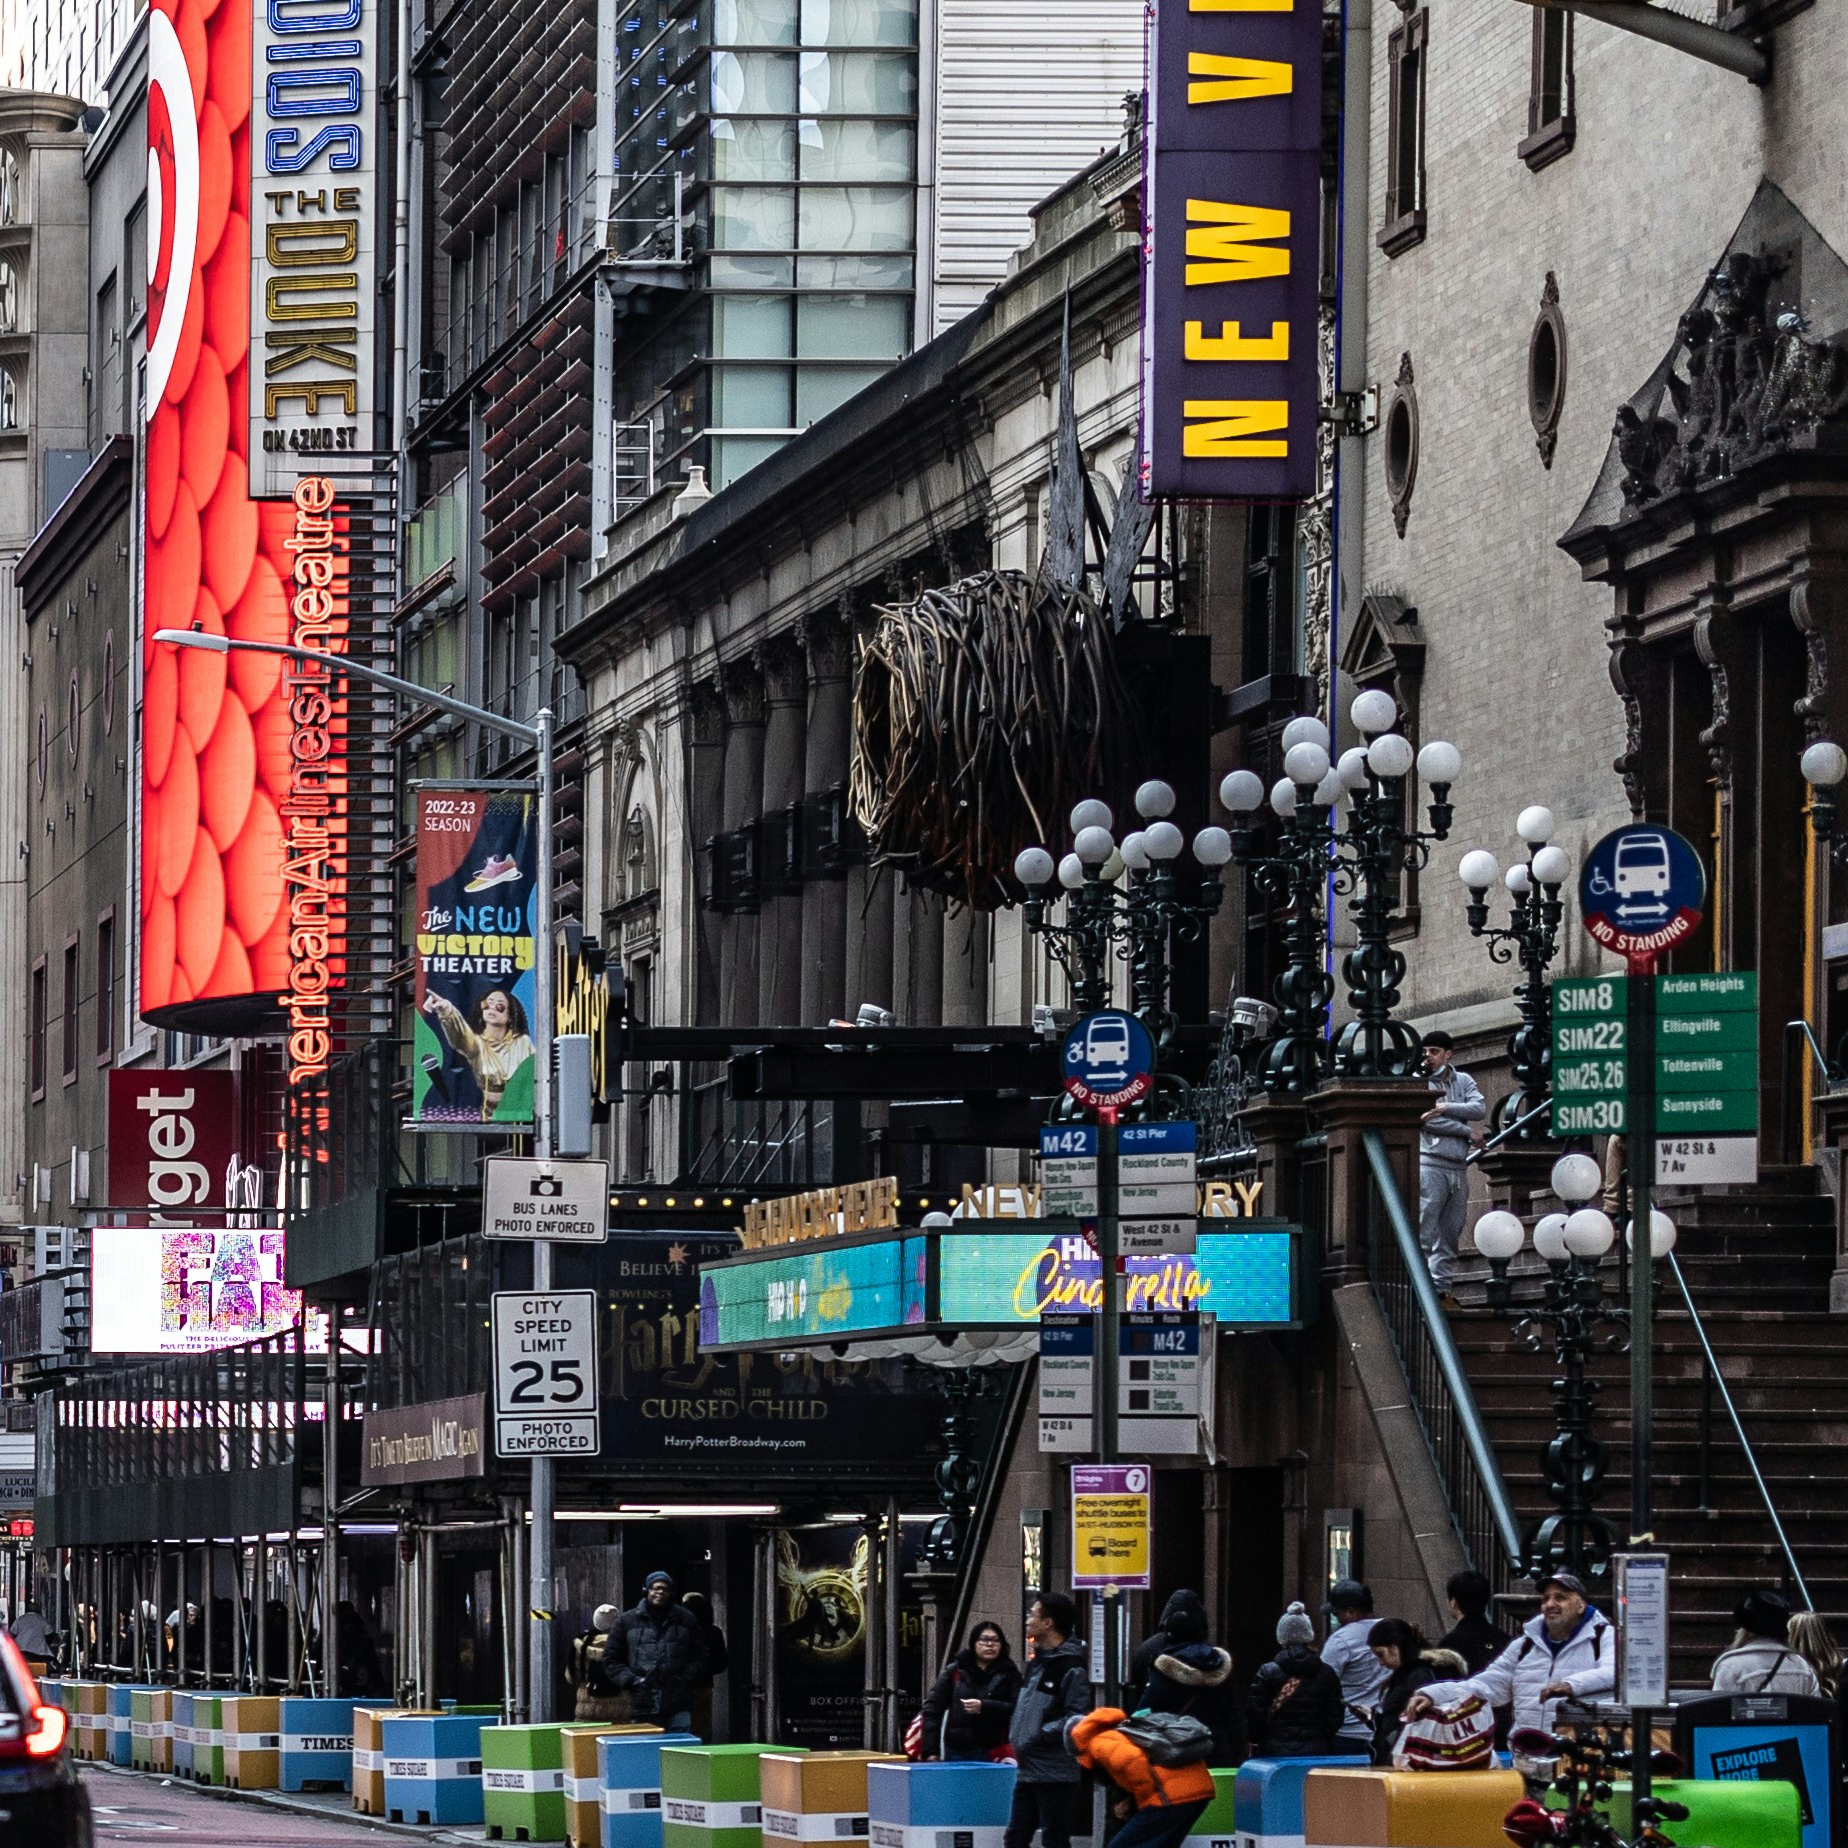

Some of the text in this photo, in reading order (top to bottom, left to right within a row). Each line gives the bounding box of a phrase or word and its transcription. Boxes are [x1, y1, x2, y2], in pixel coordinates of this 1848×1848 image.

[265, 187, 361, 214] THE
[265, 218, 358, 419] DUKE
[1182, 198, 1293, 458] NEW
[263, 425, 356, 452] ON 42ND ST
[424, 801, 475, 816] 2022-23
[424, 818, 471, 832] SEASON
[421, 906, 521, 933] The NEW
[1592, 915, 1689, 951] NO STANDING
[421, 955, 513, 974] THEATER
[1662, 977, 1744, 994] Arden Heights
[1558, 982, 1613, 1012] SIM8
[1558, 1021, 1624, 1052] SIM22
[1662, 1058, 1723, 1073] Tottenville
[1070, 1078, 1145, 1106] NO STANDING
[1662, 1098, 1723, 1114] Sunnyside
[1558, 1100, 1624, 1130] SIM30
[1043, 1131, 1087, 1153] M42
[1122, 1129, 1168, 1140] 42 St Pier
[136, 1087, 210, 1228] rget
[1661, 1143, 1716, 1156] W 42 St &
[1122, 1157, 1188, 1170] Rockland County
[1661, 1160, 1685, 1173] 7 Av
[512, 1202, 578, 1217] BUS LANES
[494, 1220, 595, 1234] PHOTO ENFORCED
[1122, 1226, 1145, 1235] West
[1147, 1225, 1159, 1235] 42
[1160, 1225, 1171, 1234] St
[1122, 1237, 1163, 1247] 7 Avenue
[620, 1261, 684, 1277] BELIEVE
[1012, 1249, 1211, 1318] Cinrella
[522, 1299, 563, 1316] CITY
[513, 1319, 572, 1335] SPEED
[521, 1337, 566, 1353] LIMIT
[1154, 1330, 1186, 1351] M42
[510, 1360, 585, 1403] 25
[641, 1399, 828, 1420] CURSED CHILD
[522, 1422, 572, 1435] PHOTO
[506, 1435, 589, 1450] ENFORCED
[664, 1435, 806, 1449] HarryPotterBroadway.com
[1133, 1474, 1140, 1487] 7
[1076, 1498, 1141, 1509] Free overnight
[1110, 1510, 1136, 1518] buses
[1108, 1538, 1137, 1548] Board
[1108, 1549, 1131, 1558] here
[1716, 1746, 1778, 1772] EXPLORE
